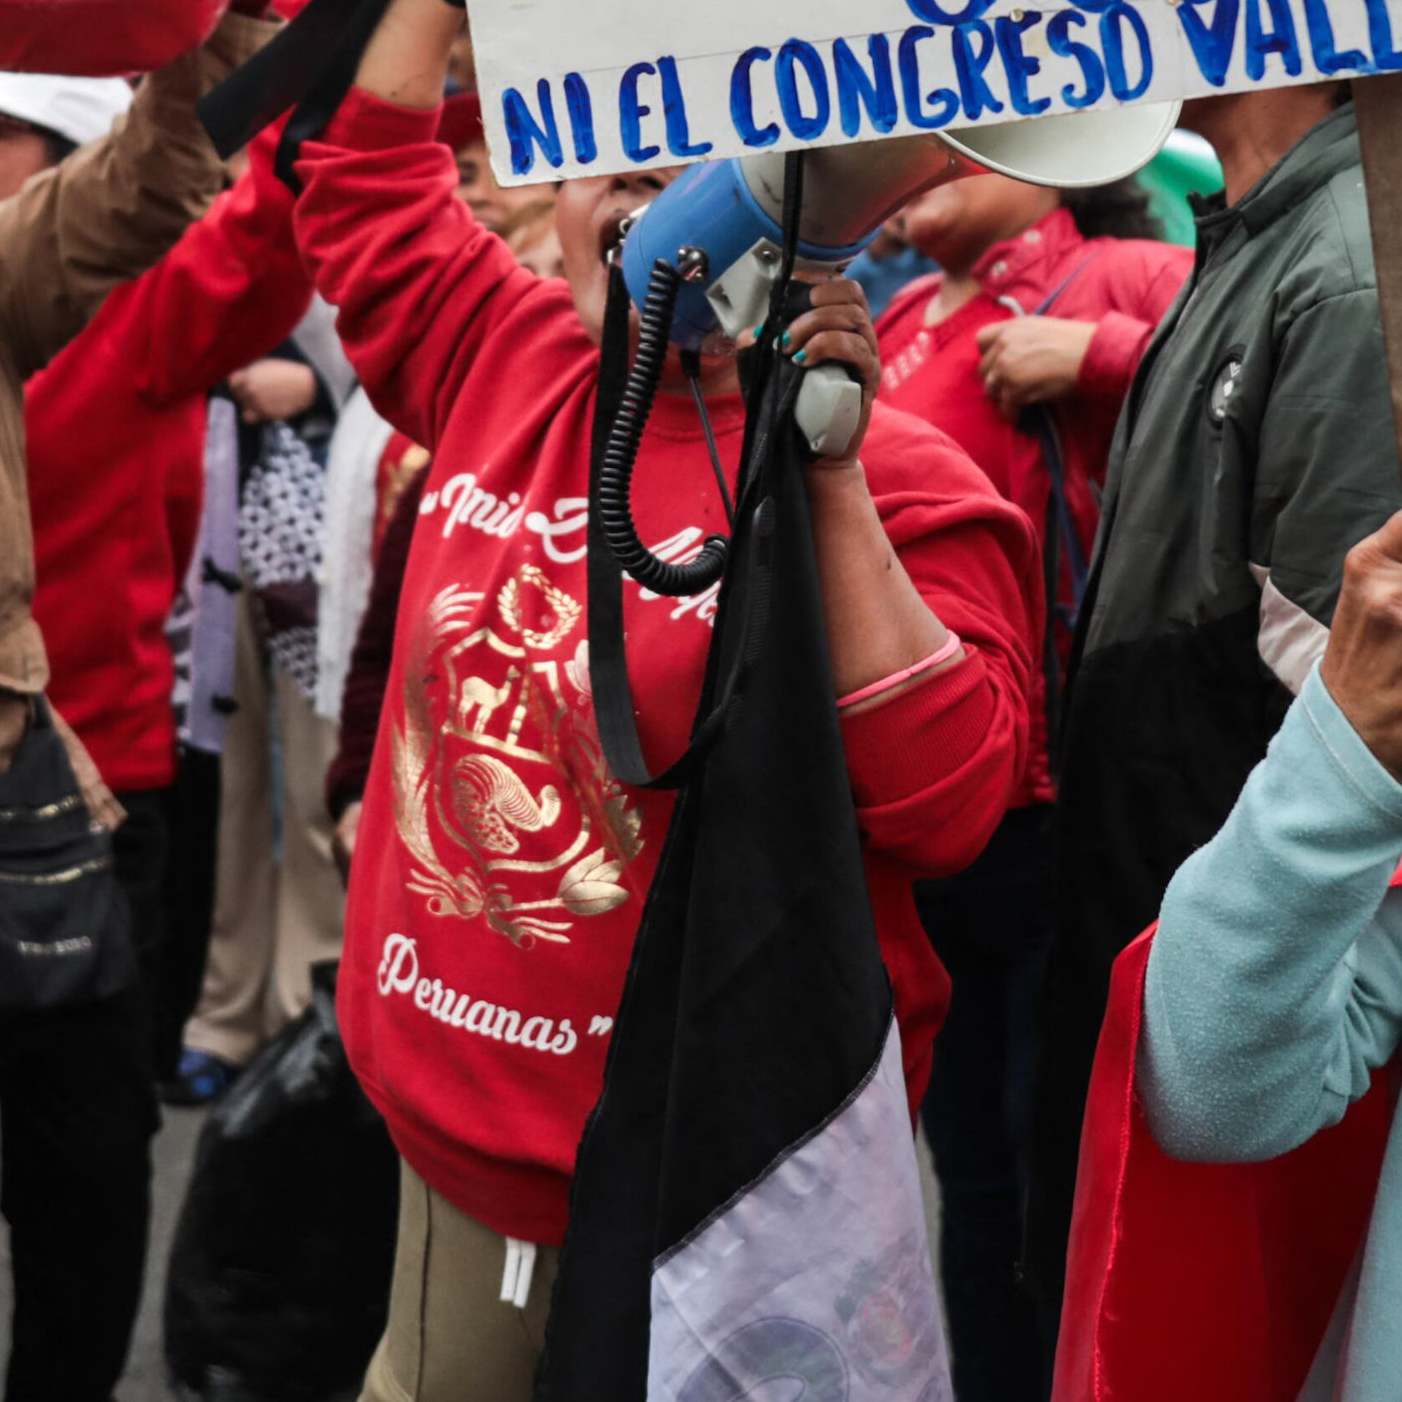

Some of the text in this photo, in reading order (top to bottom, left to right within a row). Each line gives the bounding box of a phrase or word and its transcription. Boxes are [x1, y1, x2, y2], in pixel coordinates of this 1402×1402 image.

[501, 72, 599, 177] NI
[618, 55, 713, 162] EL
[729, 4, 1155, 147] CONGRESO
